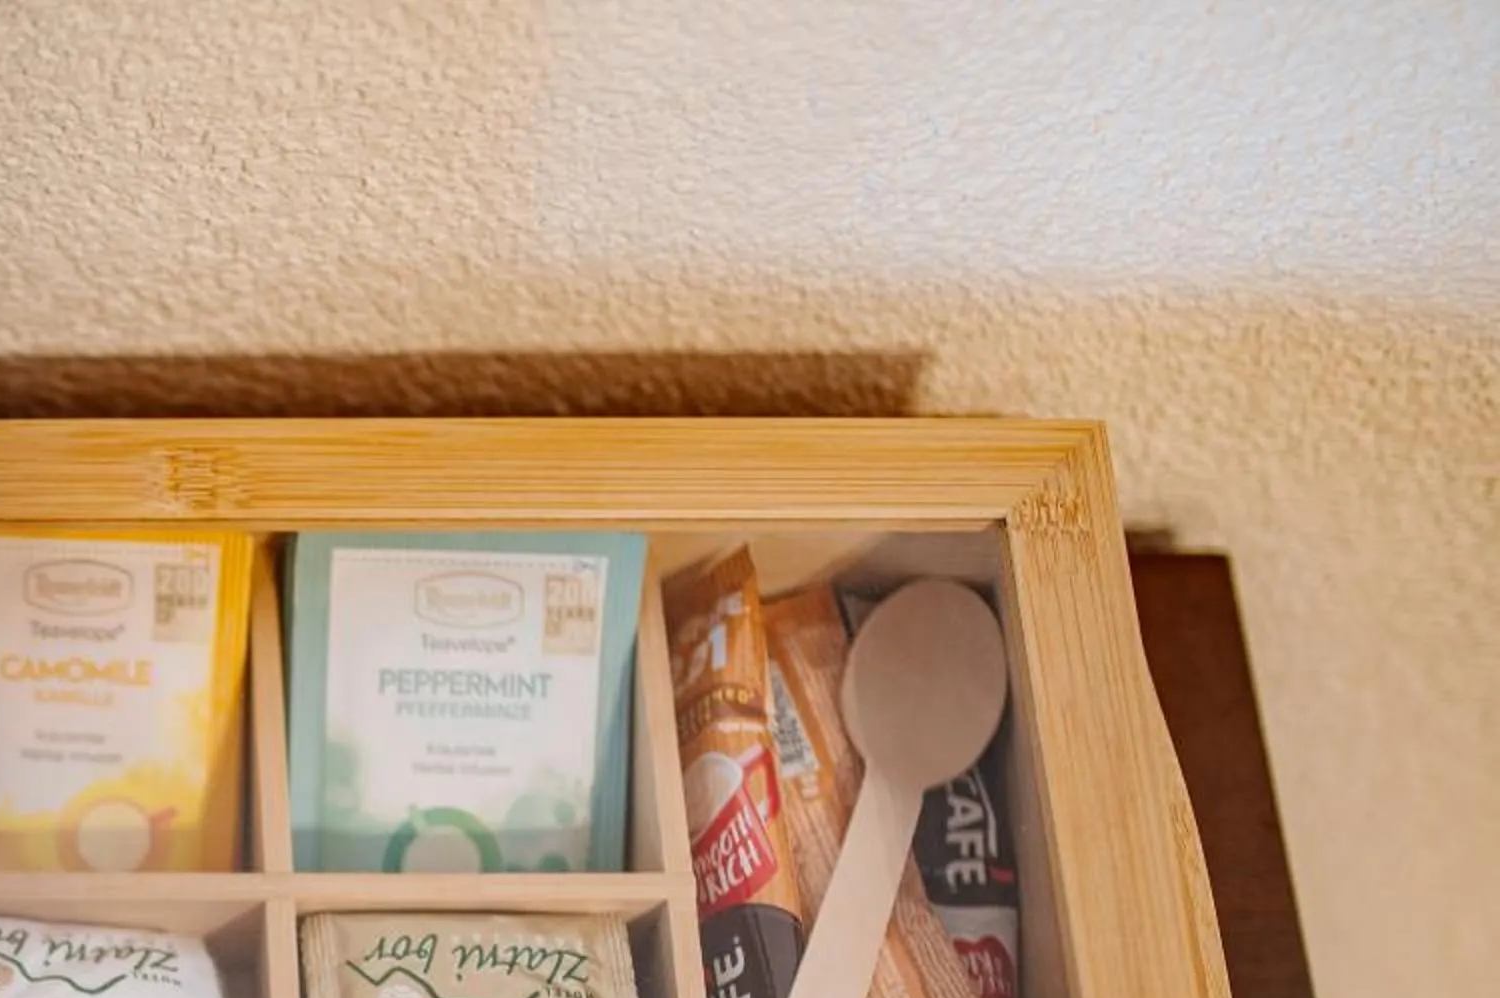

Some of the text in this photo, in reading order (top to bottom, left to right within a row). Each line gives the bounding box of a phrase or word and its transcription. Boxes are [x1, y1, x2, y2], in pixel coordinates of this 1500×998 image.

[378, 668, 553, 700] PEPPERMINT
[364, 933, 590, 985] Zlatni bor
